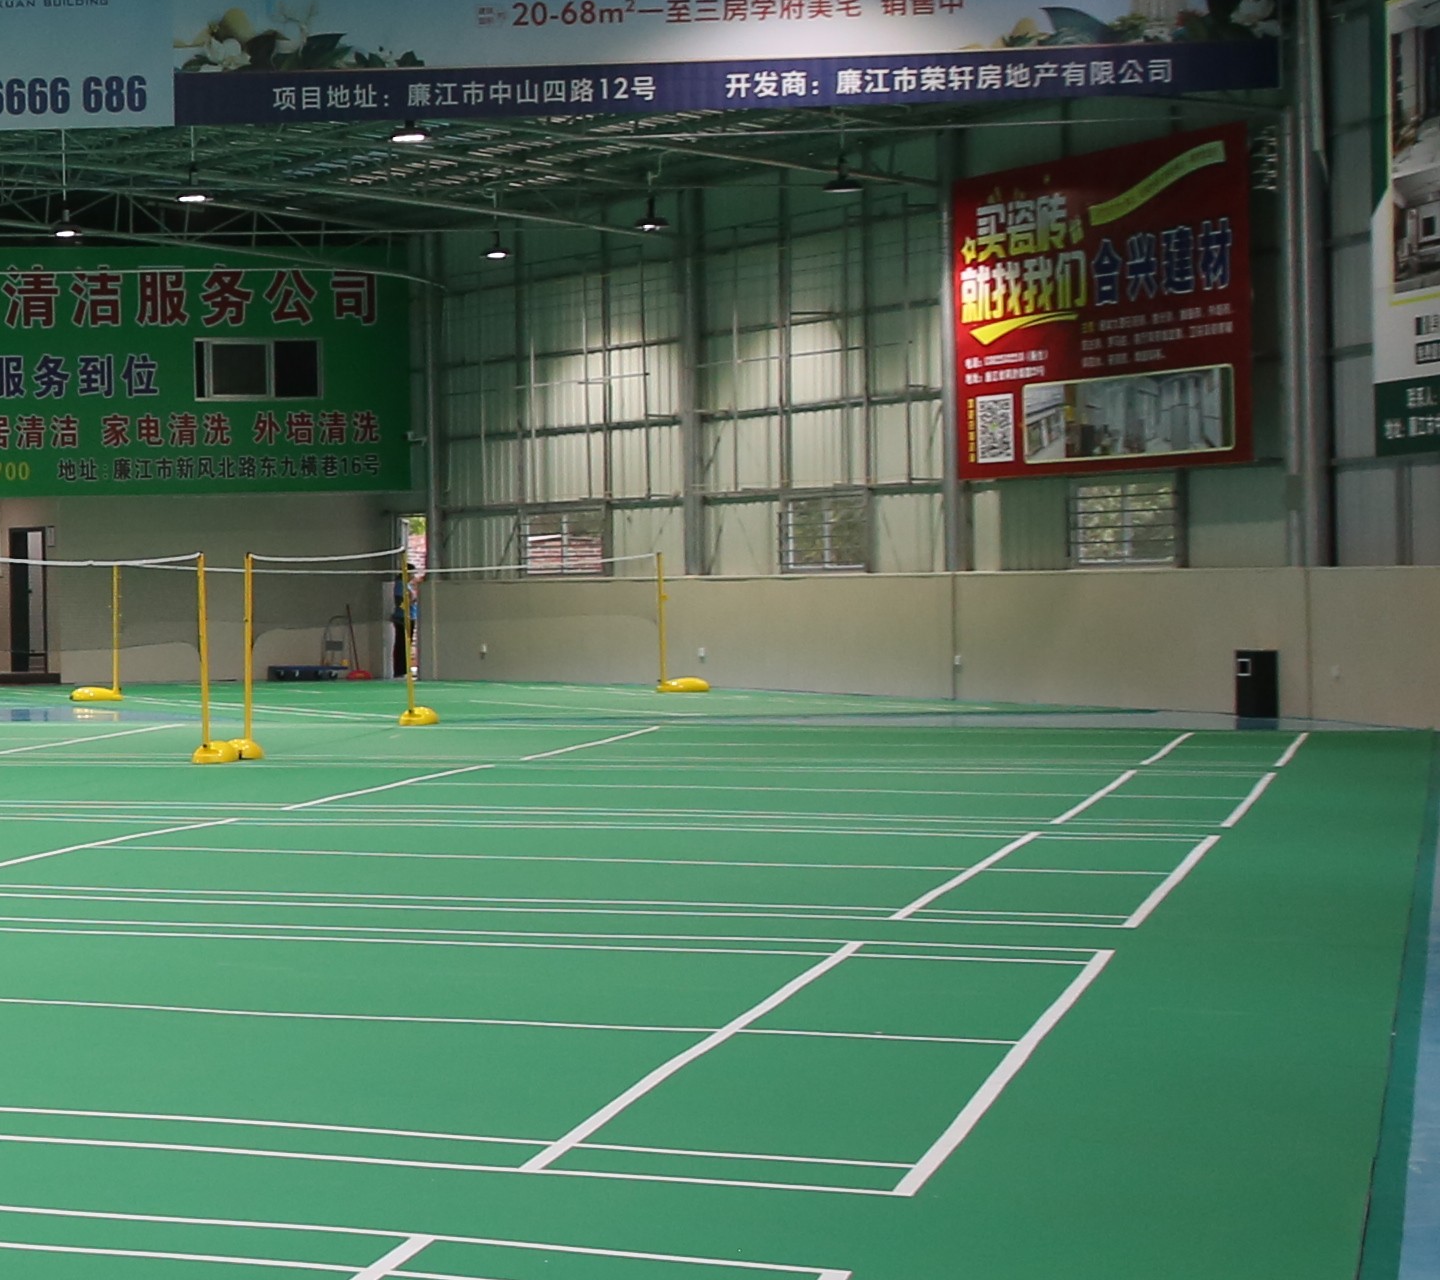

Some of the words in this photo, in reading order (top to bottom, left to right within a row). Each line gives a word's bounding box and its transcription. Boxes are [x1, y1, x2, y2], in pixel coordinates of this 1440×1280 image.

[82, 75, 147, 114] 686
[272, 82, 389, 111] 项目地址：
[407, 74, 657, 107] 廉江市中山四路12号
[725, 69, 819, 99] 开发商：
[835, 58, 1174, 97] 廉江市荣轩房地产有限公司
[976, 192, 1067, 262] 买瓷砖
[1093, 216, 1232, 307] 合兴建材
[961, 250, 1088, 323] 就找我们
[101, 412, 232, 448] 家电清洗
[252, 410, 382, 445] 外墙清洗
